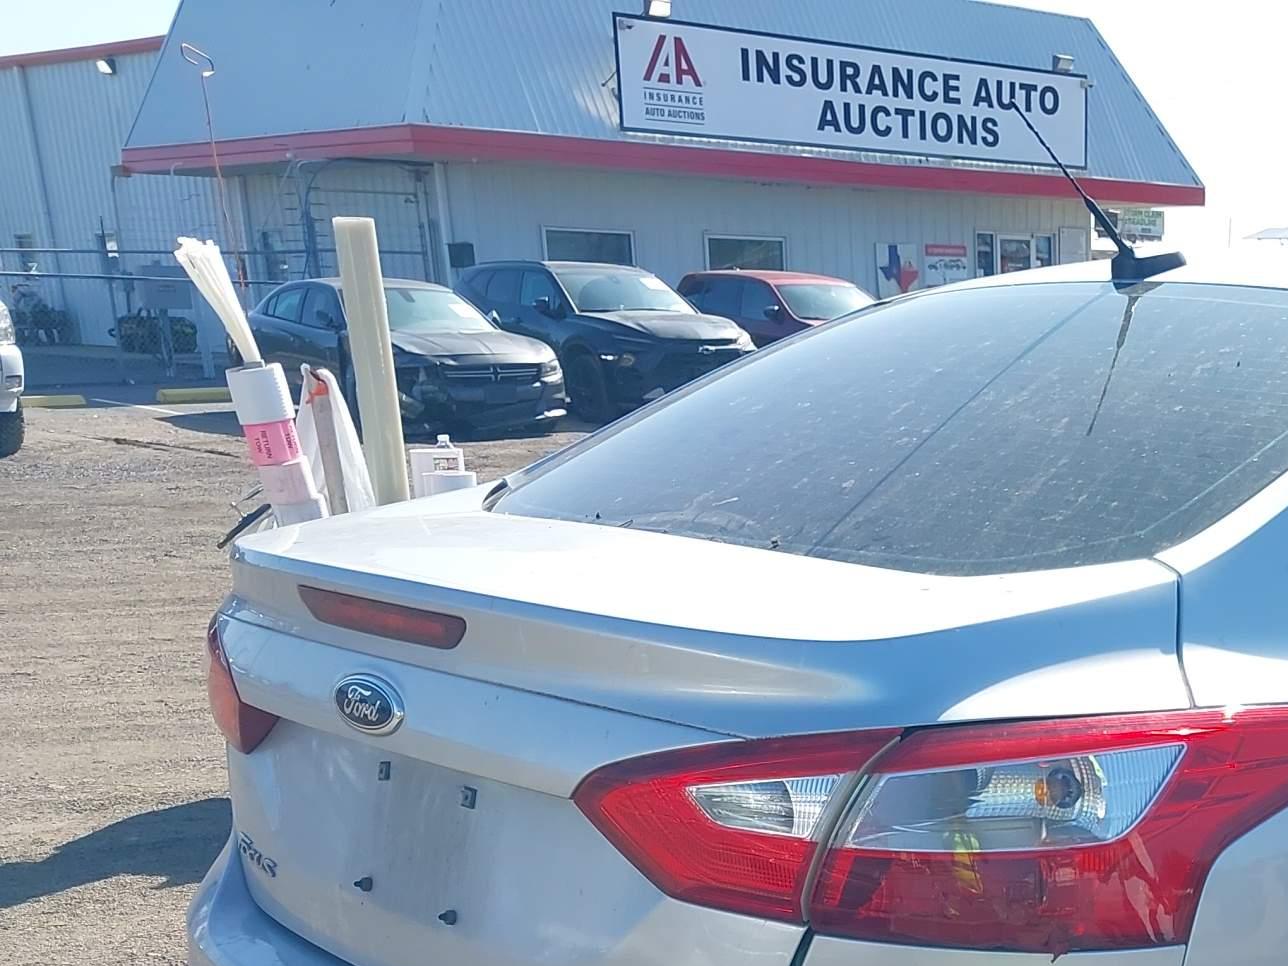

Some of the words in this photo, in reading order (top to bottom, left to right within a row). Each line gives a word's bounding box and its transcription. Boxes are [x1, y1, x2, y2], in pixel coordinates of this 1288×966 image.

[643, 91, 704, 106] INSURANCE
[740, 47, 961, 105] INSURANCE
[973, 77, 1060, 116] AUTO
[645, 106, 666, 118] AUTO
[667, 111, 706, 121] AUCTIONS
[816, 99, 1000, 148] AUCTIONS
[343, 685, 382, 722] Ford
